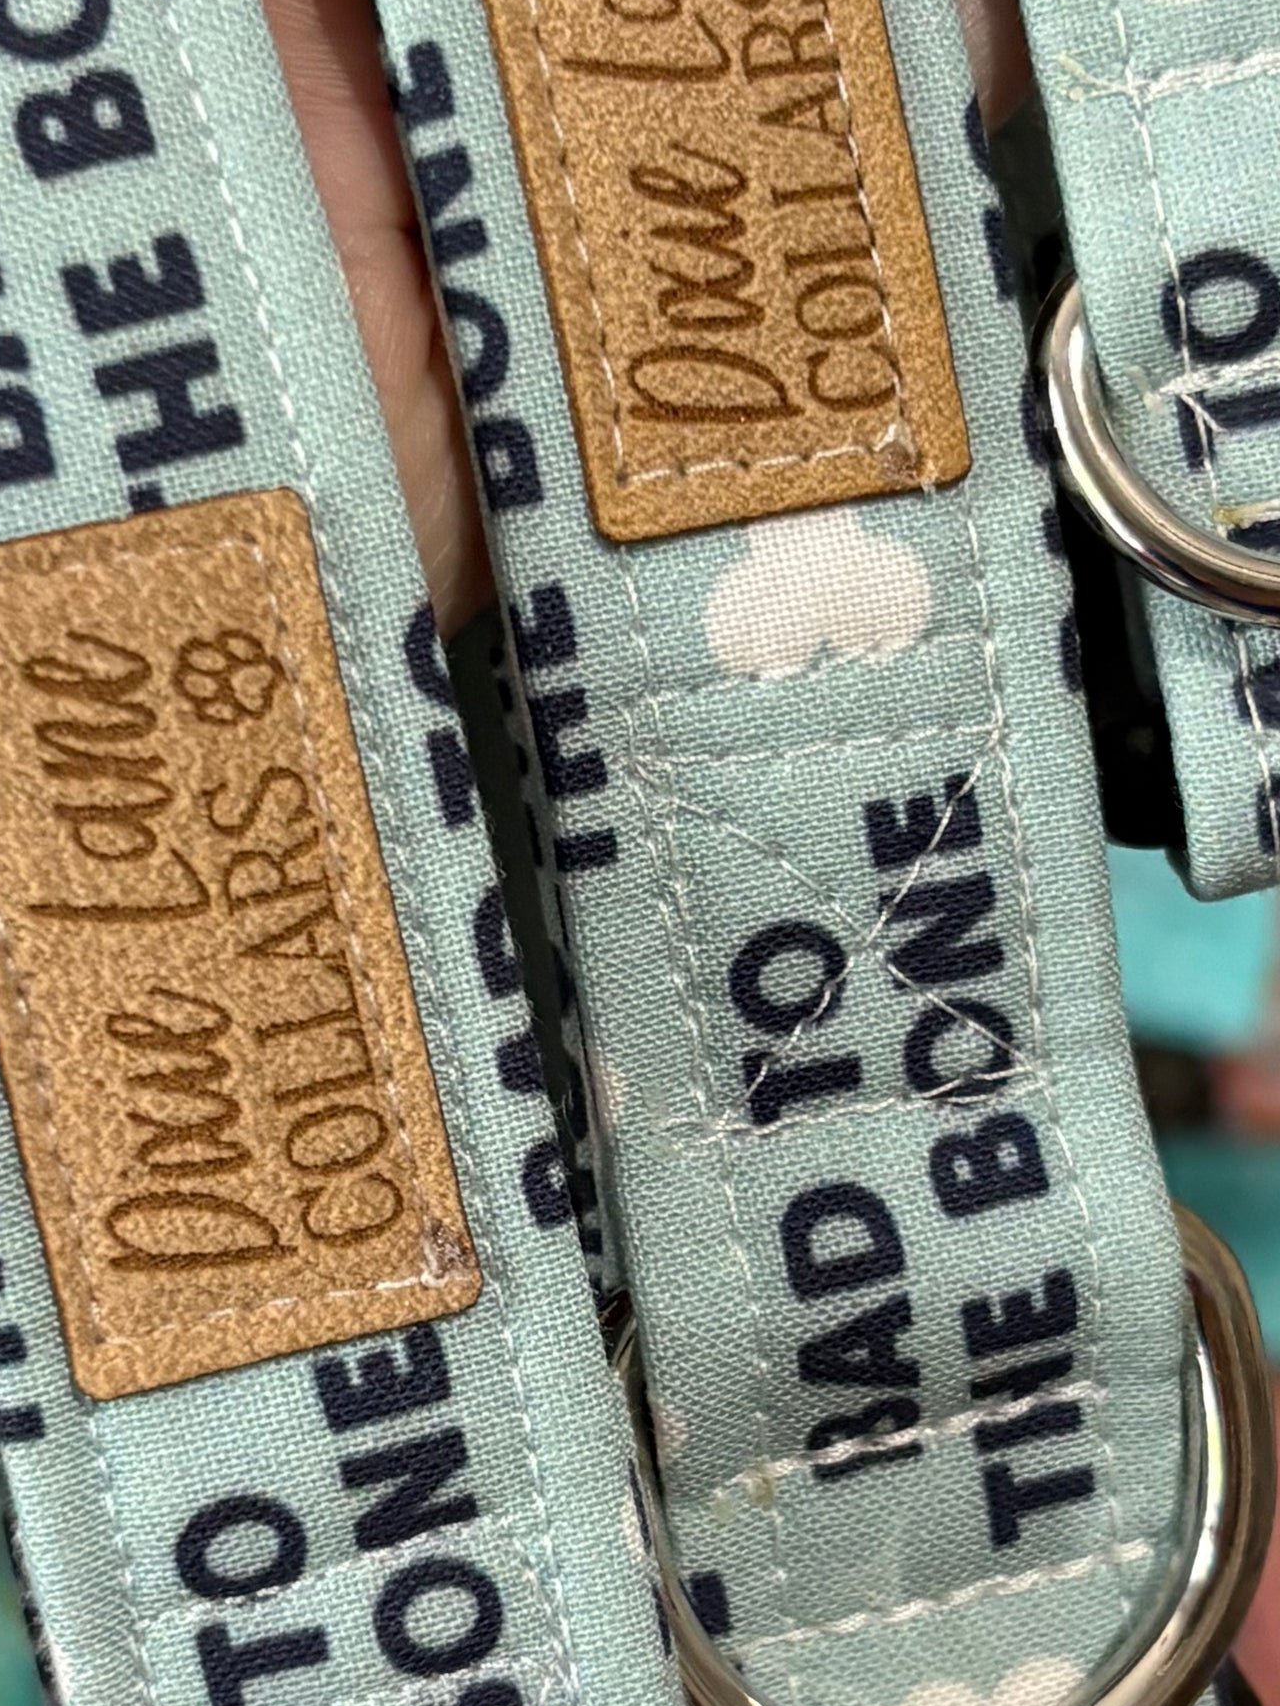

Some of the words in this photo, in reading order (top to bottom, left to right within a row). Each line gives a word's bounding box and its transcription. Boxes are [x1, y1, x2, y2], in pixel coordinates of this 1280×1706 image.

[60, 231, 246, 514] HE
[624, 142, 806, 425] Dane
[22, 630, 212, 926] Lane
[104, 987, 298, 1272] Dane
[204, 765, 405, 1249] COLLARS
[728, 920, 864, 1127] TO
[863, 772, 1050, 1218] BONE
[778, 1179, 923, 1483] BAD
[959, 1269, 1097, 1548] THE
